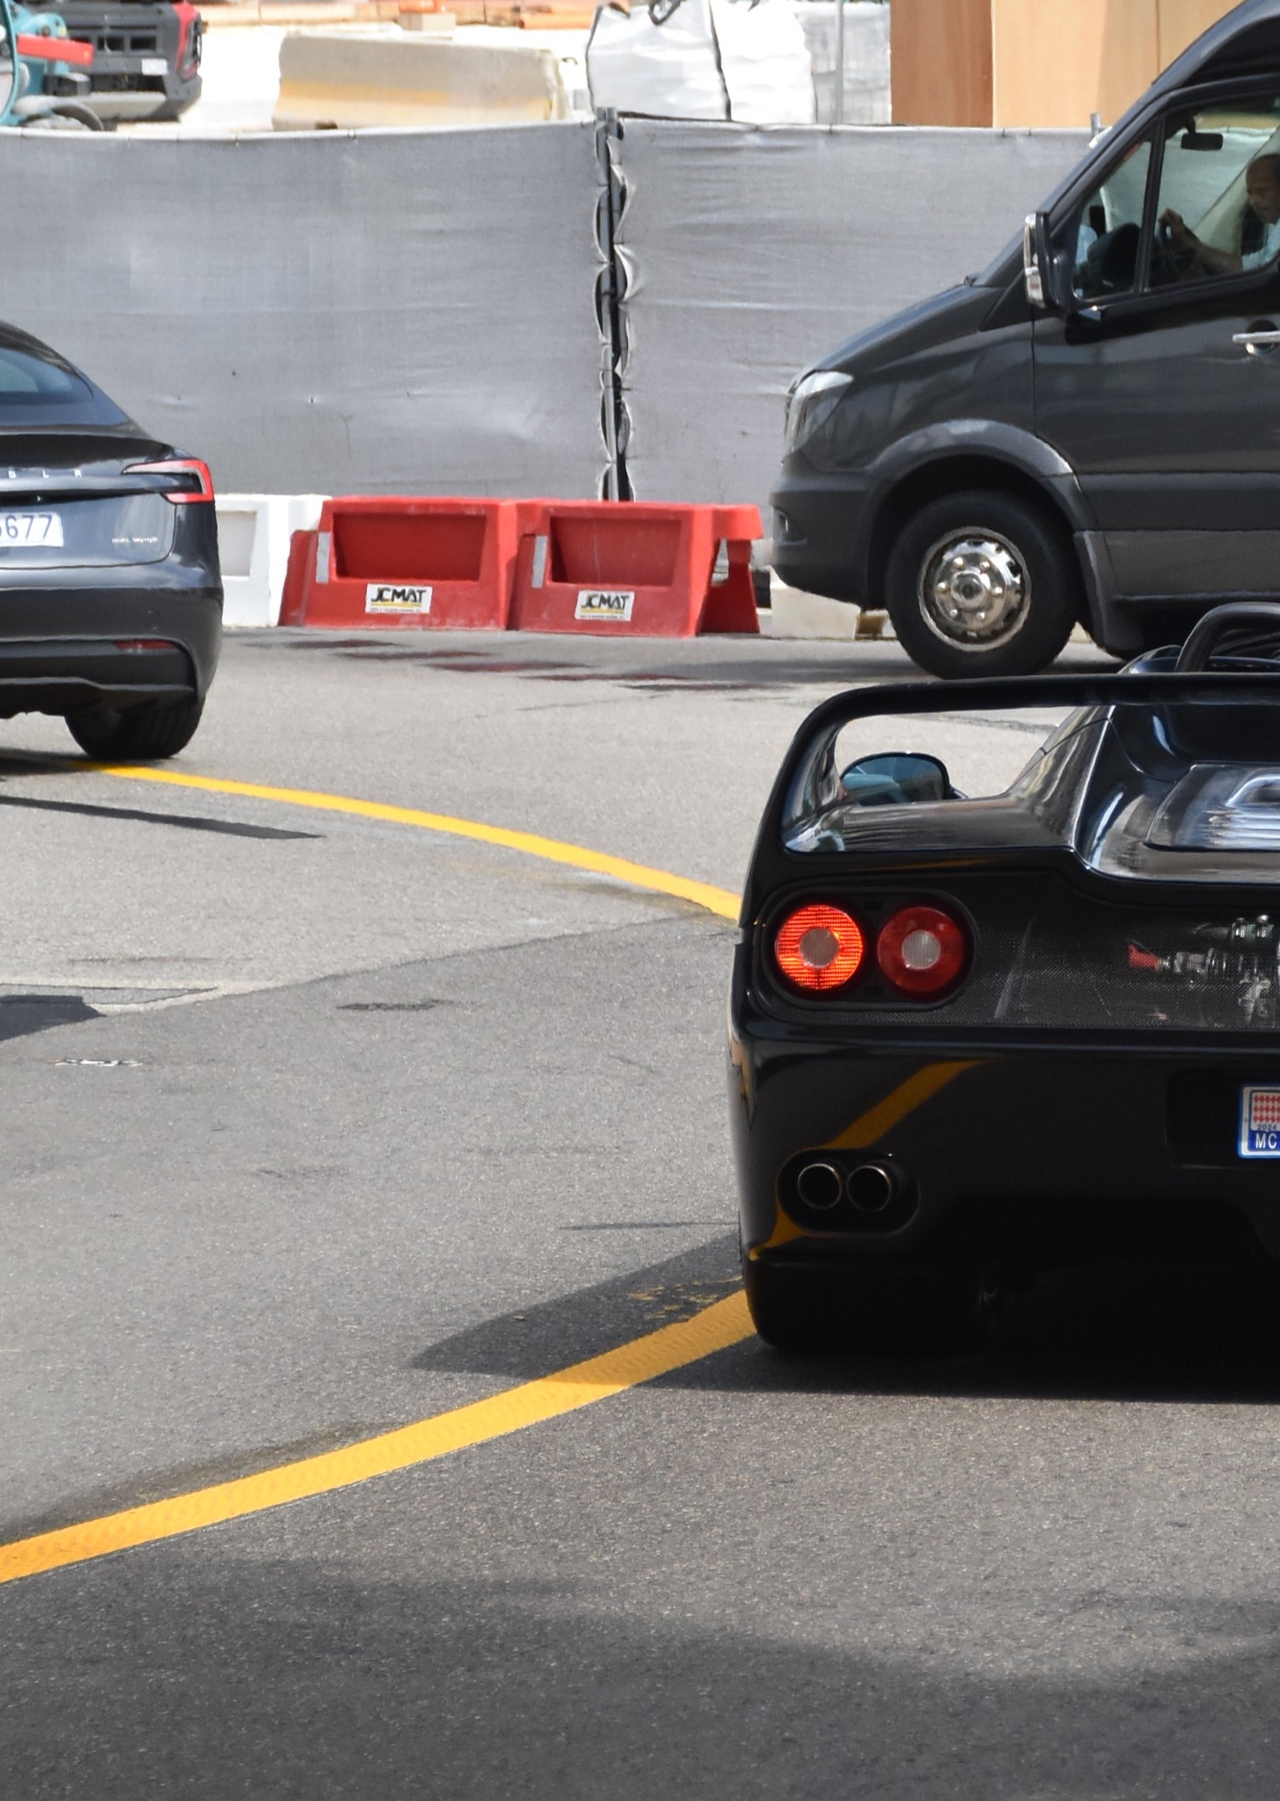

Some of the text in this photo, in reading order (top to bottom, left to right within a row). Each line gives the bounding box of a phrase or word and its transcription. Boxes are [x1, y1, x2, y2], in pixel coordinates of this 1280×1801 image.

[0, 514, 53, 541] 677
[371, 587, 426, 603] JCMAT
[581, 593, 630, 609] JCMAT
[1256, 1133, 1278, 1149] MC
